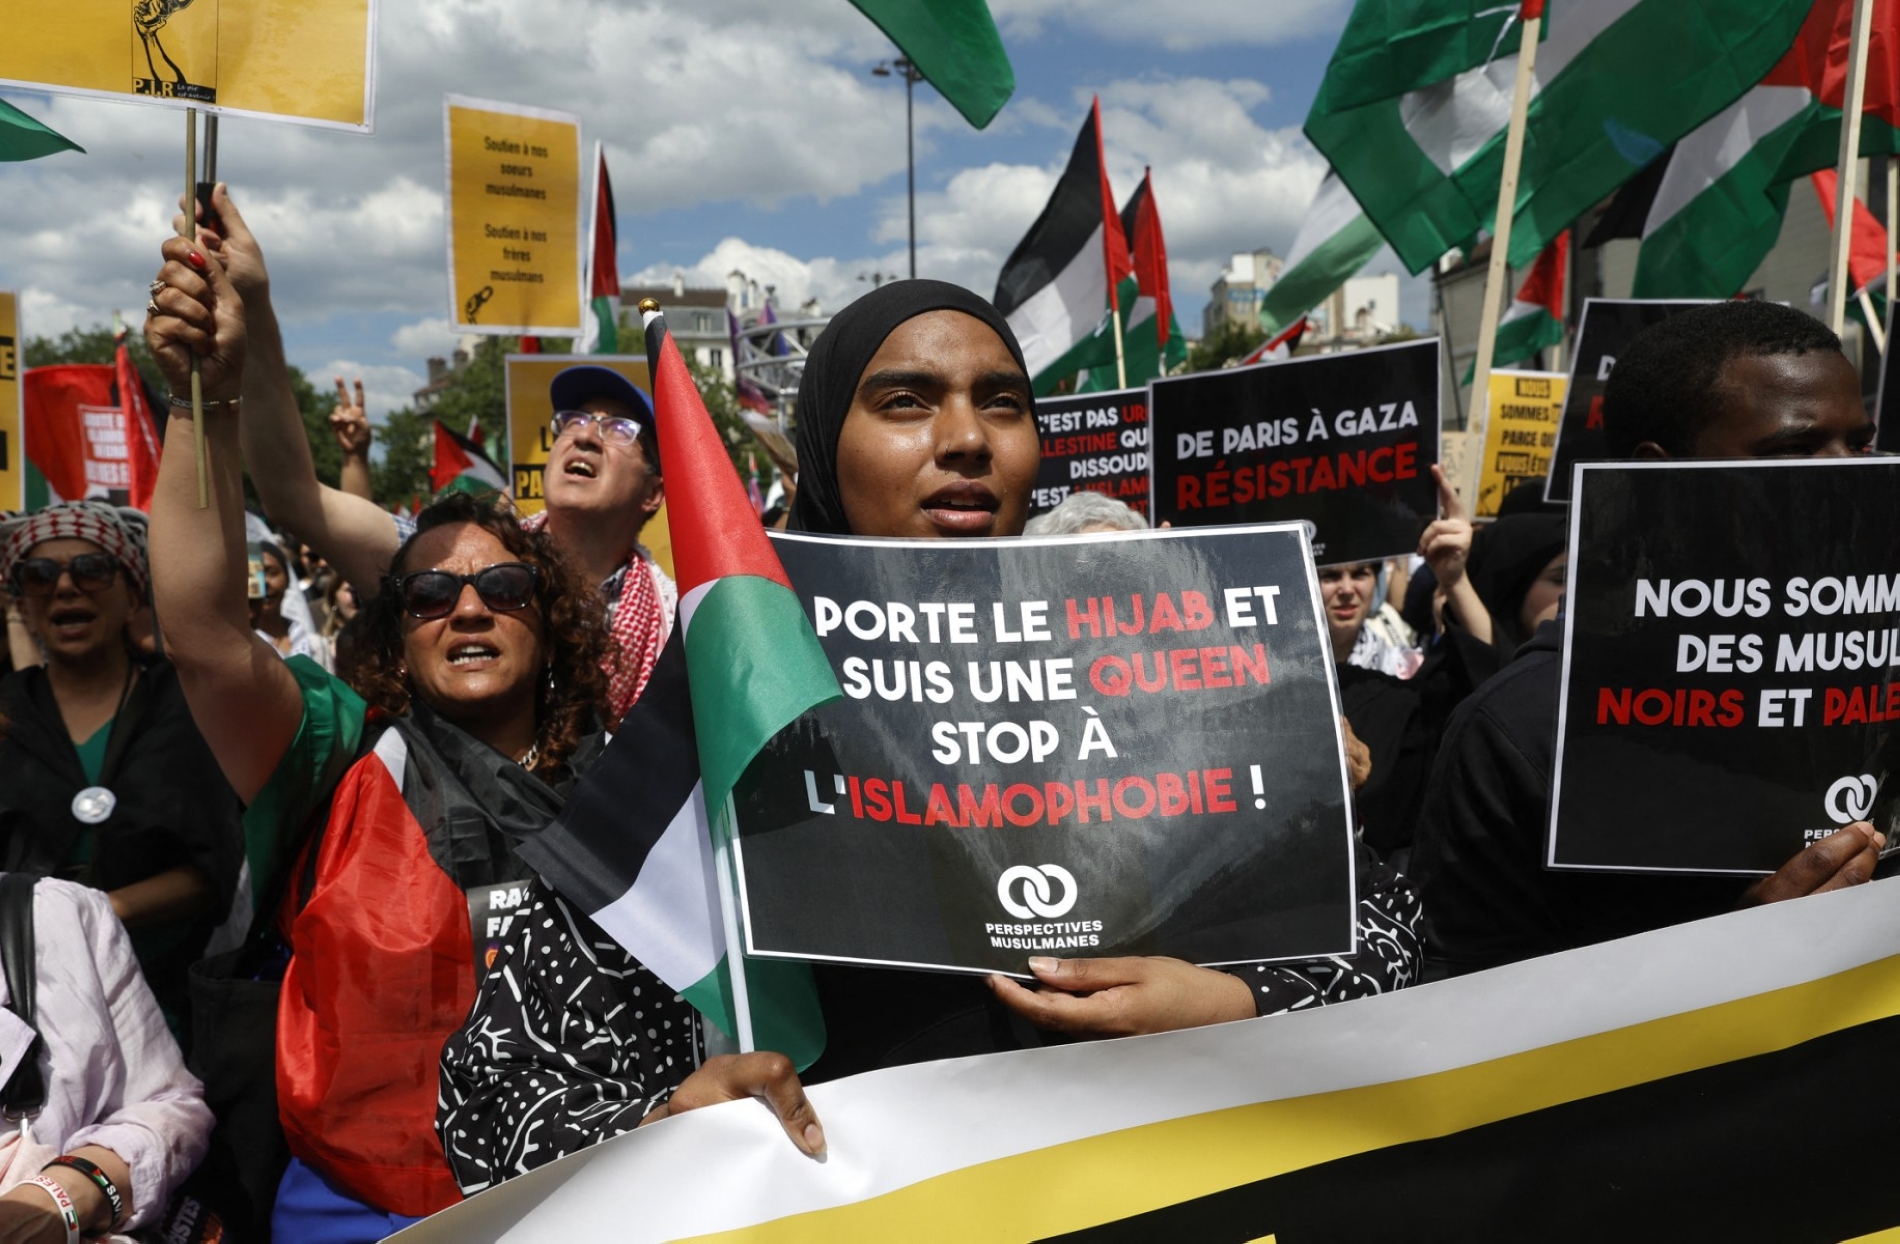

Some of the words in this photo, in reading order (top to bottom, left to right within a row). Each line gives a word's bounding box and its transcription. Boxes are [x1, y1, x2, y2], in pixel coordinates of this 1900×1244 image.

[484, 135, 521, 155] Soutien
[523, 141, 530, 156] à
[531, 145, 549, 158] nos
[500, 162, 533, 178] soeurs
[485, 182, 547, 201] musulmanes
[484, 222, 521, 240] Soutien
[522, 228, 529, 242] à
[530, 231, 547, 243] nos
[502, 246, 532, 262] frères
[490, 268, 545, 284] musulmans
[1086, 406, 1119, 429] PAS
[1500, 403, 1549, 422] SOMMES
[1177, 430, 1214, 460] DE
[1223, 417, 1299, 454] PARIS
[1306, 408, 1329, 442] À
[1334, 400, 1418, 437] GAZA
[1501, 430, 1537, 447] PARCE
[1040, 431, 1117, 458] LESTINE
[1177, 442, 1418, 510] RÉSISTANCE
[1634, 577, 1772, 618] NOUS
[814, 596, 978, 643] PORTE
[993, 600, 1052, 643] LE
[1066, 590, 1215, 639] HIJAB
[1223, 585, 1281, 628] ET
[1676, 633, 1764, 674] DES
[843, 656, 955, 703] SUIS
[968, 658, 1077, 702] UNE
[1089, 643, 1271, 697] QUEEN
[1596, 687, 1745, 728] NOIRS
[1758, 688, 1812, 727] ET
[932, 720, 1059, 765] STOP
[1077, 706, 1118, 760] À
[804, 767, 1237, 828] L'ISLAMOPHOBIE
[1249, 764, 1266, 809] !
[985, 920, 1103, 935] PERSPECTIVES
[990, 934, 1100, 949] MUSULMANES
